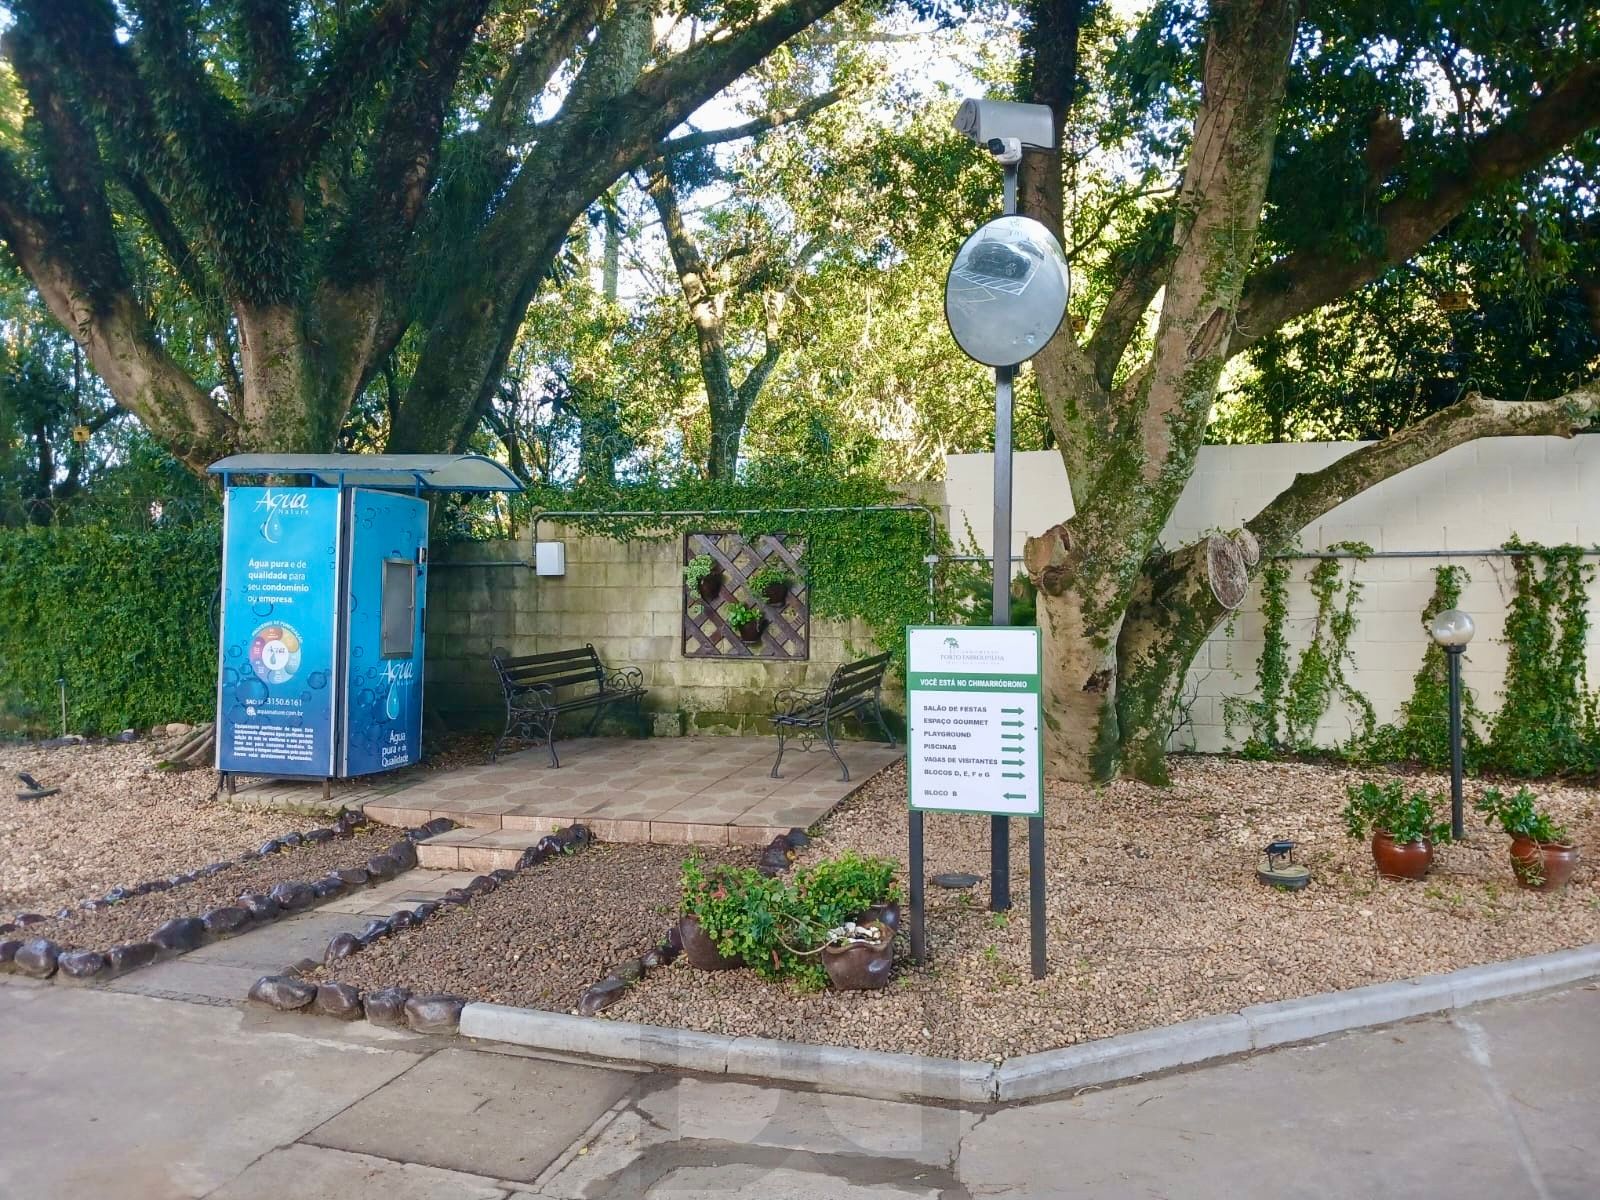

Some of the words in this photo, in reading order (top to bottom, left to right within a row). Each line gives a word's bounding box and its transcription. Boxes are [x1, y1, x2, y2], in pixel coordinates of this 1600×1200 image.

[270, 561, 289, 569] pura
[296, 560, 307, 568] de
[248, 571, 288, 580] qualidade
[247, 583, 260, 591] seu
[262, 583, 310, 592] condomínio
[920, 678, 938, 686] VOCÊ
[939, 678, 956, 687] ESTÁ
[957, 680, 968, 688] NO
[968, 679, 1028, 688] CHIMARRÓDROMO
[266, 698, 302, 706] 3150.6161
[389, 730, 406, 744] Água
[382, 746, 396, 757] pura
[382, 754, 408, 768] Qualidade
